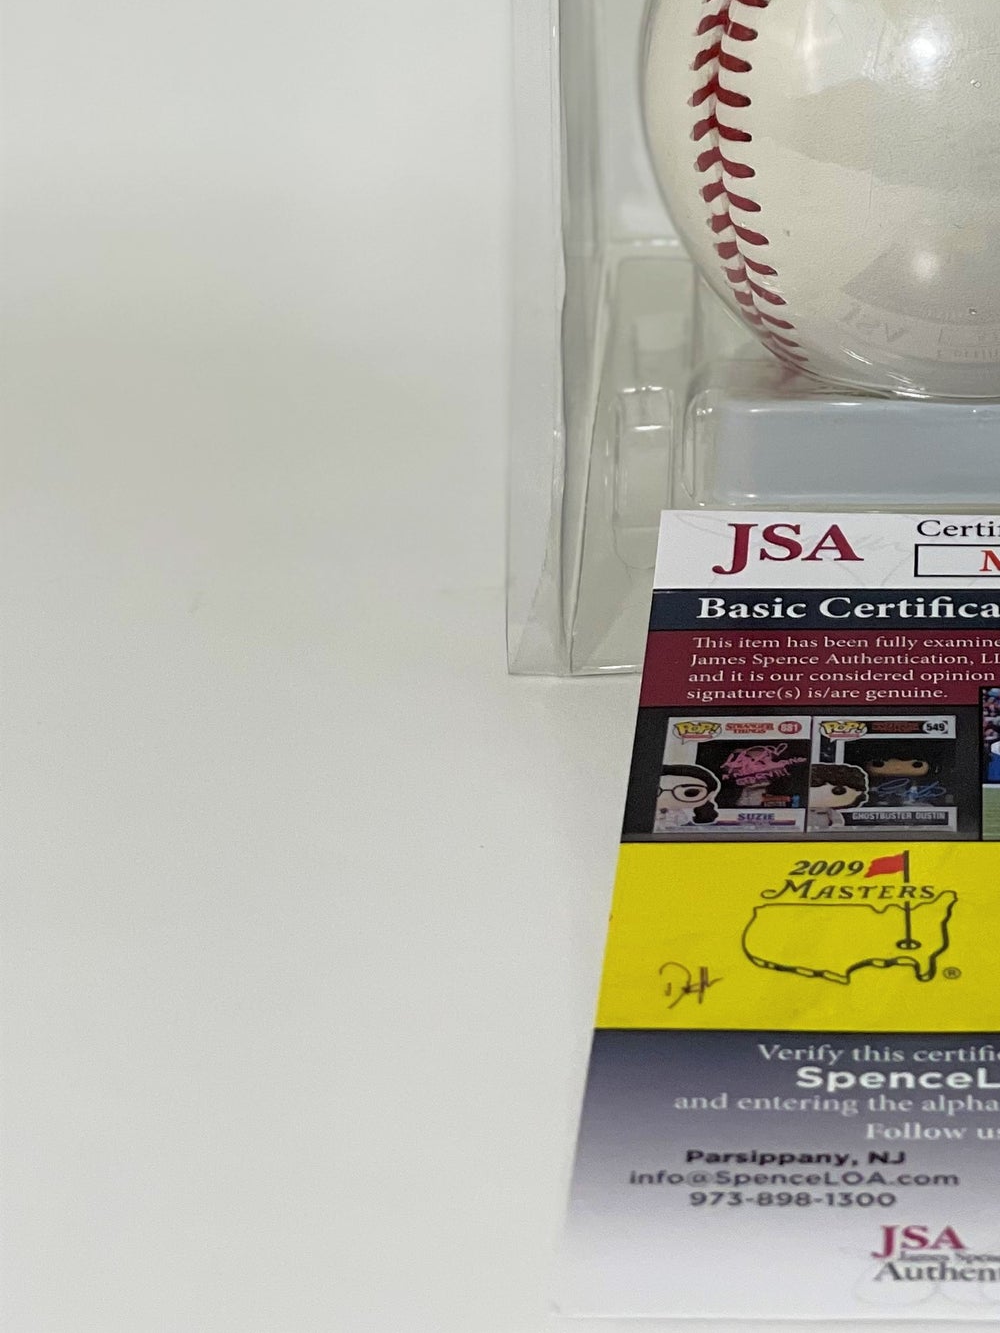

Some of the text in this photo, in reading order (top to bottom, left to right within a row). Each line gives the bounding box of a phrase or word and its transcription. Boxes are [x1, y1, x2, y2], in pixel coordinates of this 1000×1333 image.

[712, 523, 865, 575] JSA
[696, 597, 807, 619] Basic
[692, 636, 733, 649] This
[739, 637, 780, 649] item
[787, 636, 818, 648] has
[823, 636, 869, 649] been
[875, 635, 918, 651] fully
[690, 654, 746, 667] James
[752, 653, 820, 668] Spence
[825, 652, 974, 666] Authentication,
[688, 670, 724, 682] and
[731, 670, 743, 682] it
[750, 669, 764, 682] is
[769, 672, 804, 682] our
[809, 669, 914, 682] considered
[920, 669, 995, 686] opinion
[686, 686, 948, 703] signature(s) is/are genuine.
[925, 722, 945, 732] 549
[737, 813, 775, 821] SUZIE
[852, 812, 912, 820] GHOSTBUSTER
[788, 859, 865, 876] 2009
[757, 1043, 844, 1065] Verify
[852, 1044, 905, 1063] this
[674, 1091, 728, 1111] and
[737, 1091, 859, 1118] entering
[867, 1093, 913, 1112] the
[866, 1121, 967, 1141] Follow
[685, 1149, 906, 1168] Parsippany, NJ
[629, 1169, 959, 1189] info@SpenceLOA.com
[689, 1191, 897, 1209] 973-898-1300
[870, 1224, 968, 1260] JSA
